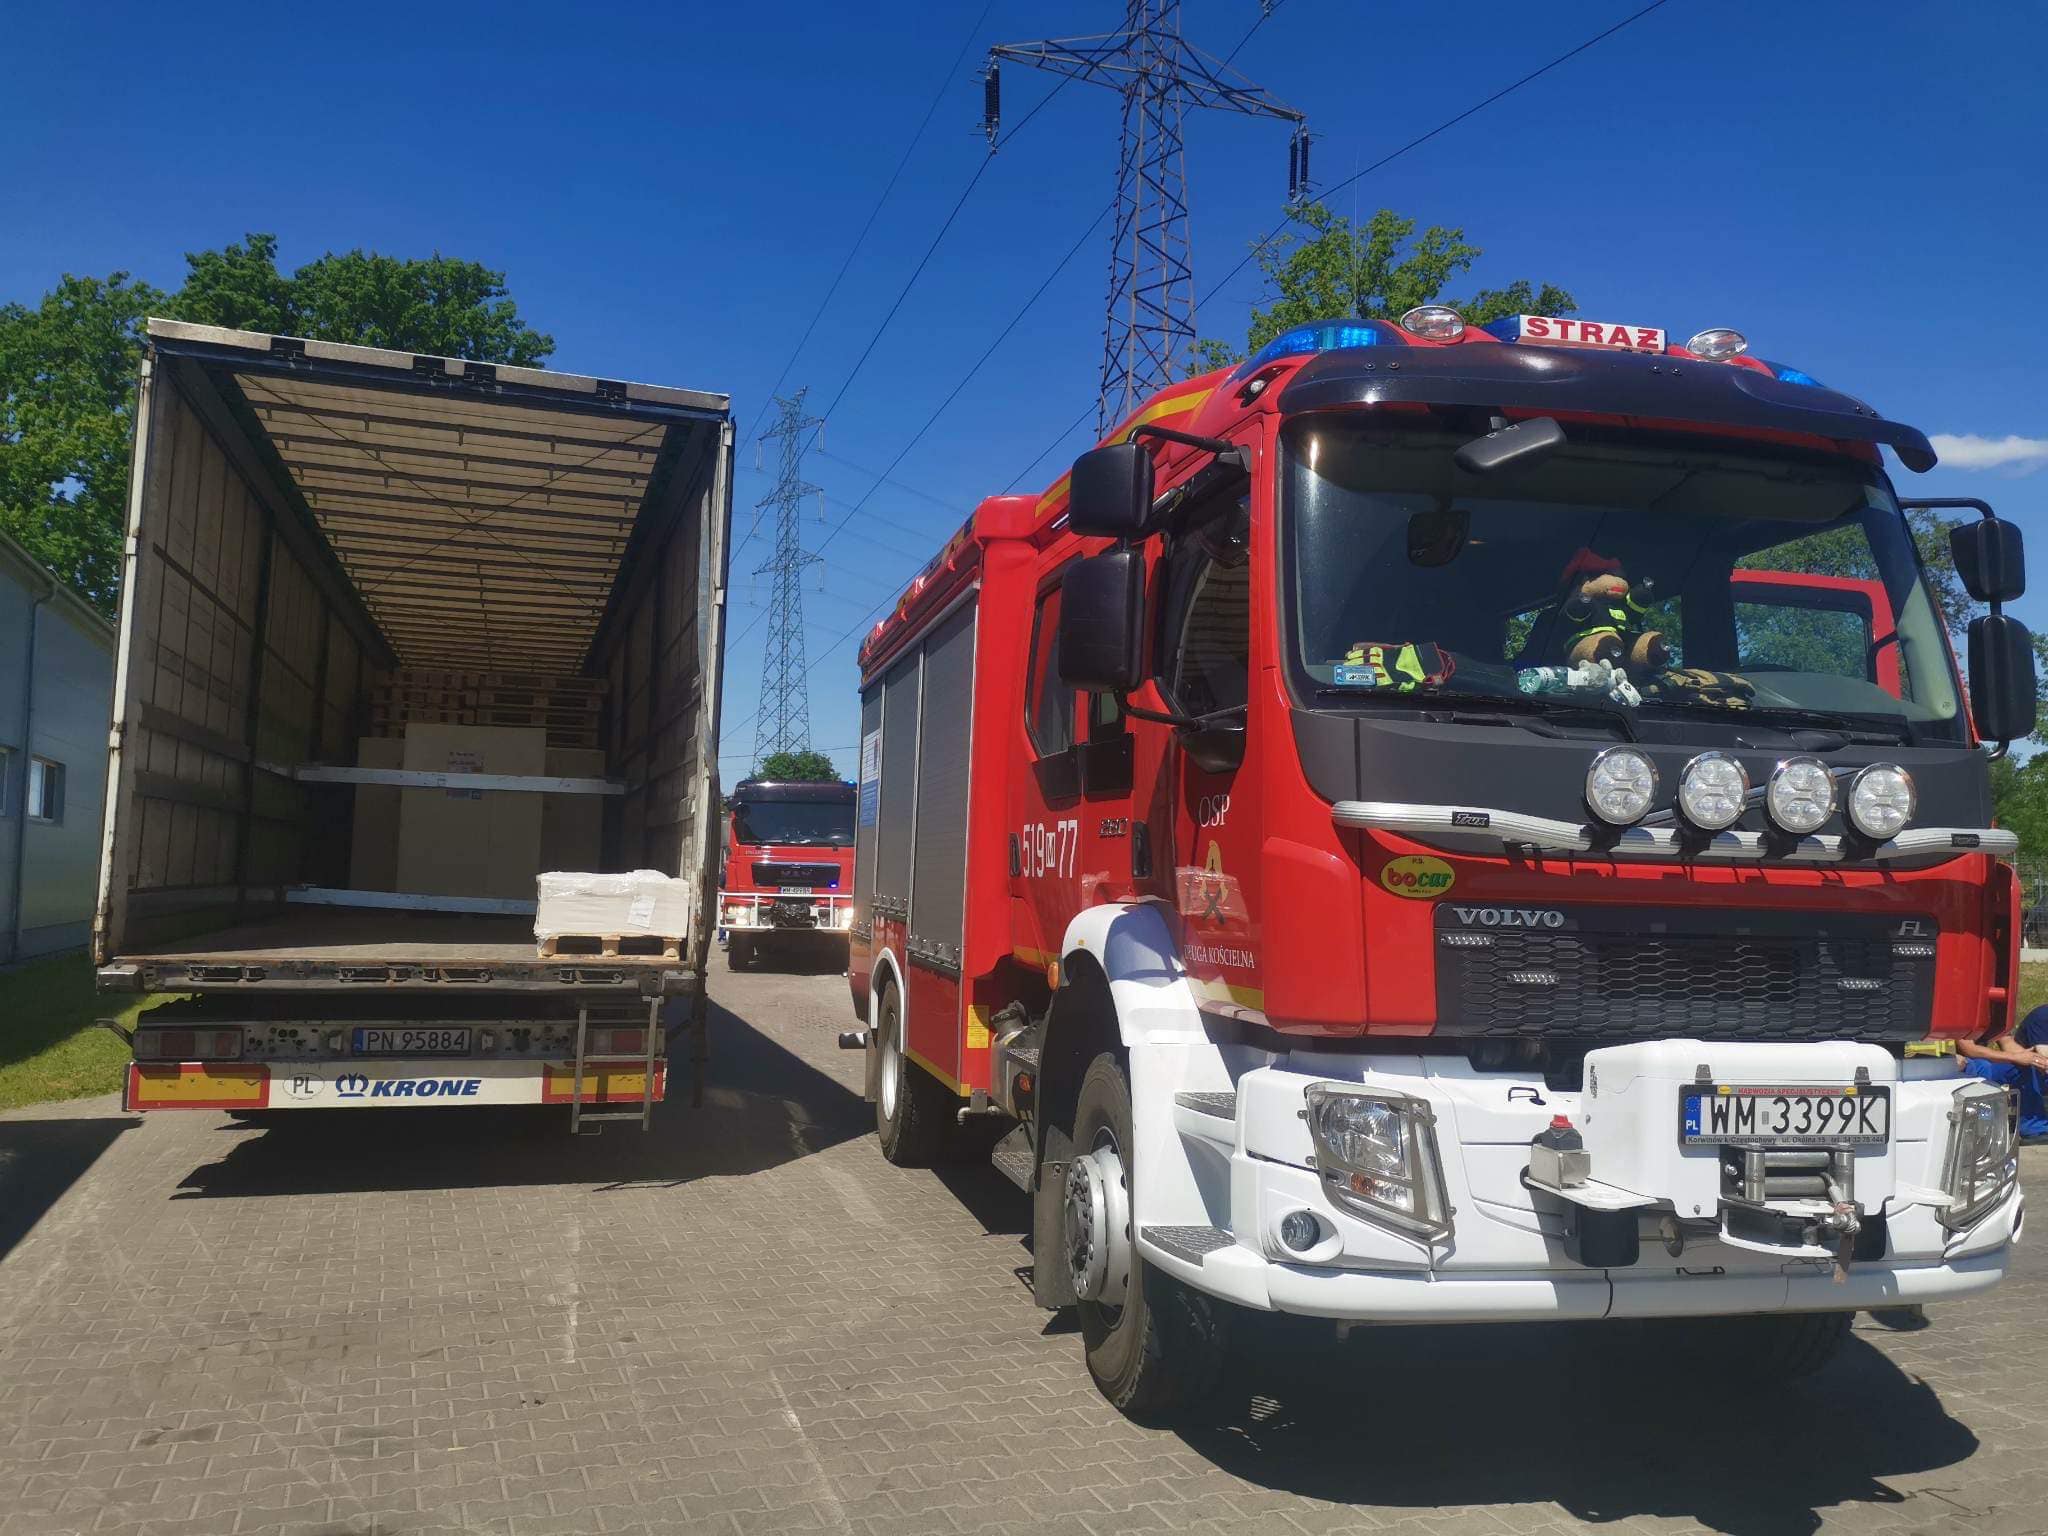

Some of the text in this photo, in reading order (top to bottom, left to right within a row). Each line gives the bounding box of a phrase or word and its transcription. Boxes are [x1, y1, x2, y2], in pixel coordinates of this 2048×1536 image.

[1199, 795, 1230, 828] OSP
[1387, 868, 1451, 888] bocar
[1452, 907, 1565, 928] VOLVO
[1898, 920, 1928, 937] FL
[1208, 945, 1255, 969] KOŚCIELNA
[367, 1031, 394, 1050] PN
[402, 1031, 466, 1050] 95884
[293, 1076, 314, 1094] PL
[371, 1079, 482, 1097] KRONE
[1685, 1119, 1699, 1130] PL
[1711, 1096, 1878, 1134] WM 3399K
